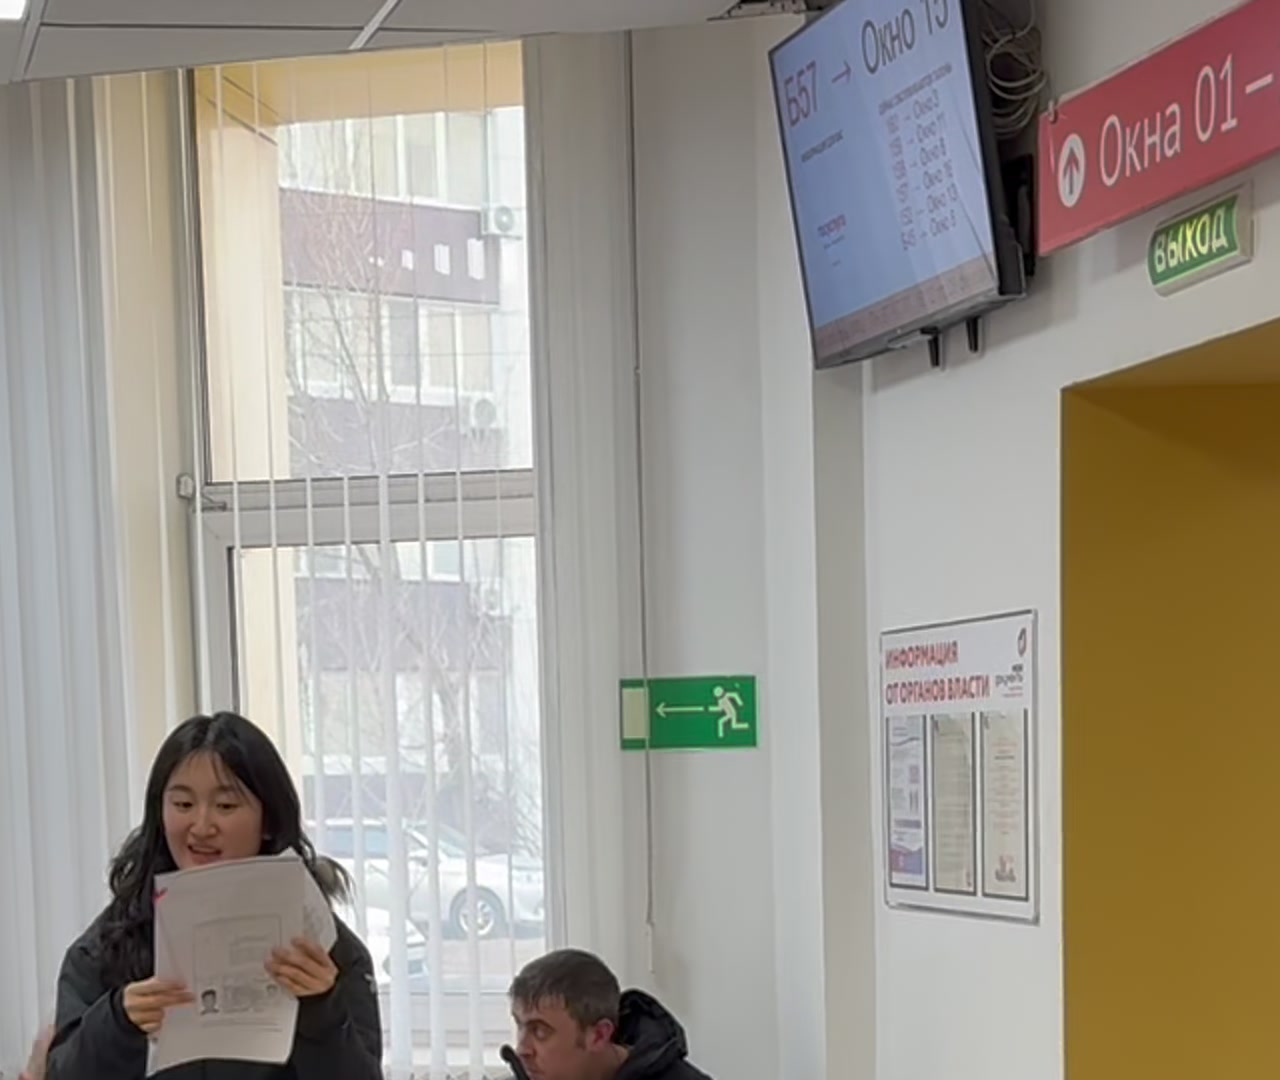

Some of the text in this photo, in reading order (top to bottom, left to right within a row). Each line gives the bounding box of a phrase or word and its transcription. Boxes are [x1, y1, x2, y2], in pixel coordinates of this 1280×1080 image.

[861, 8, 915, 75] Окно
[1099, 102, 1181, 187] Окна
[1153, 206, 1229, 274] ВЫХОД
[885, 640, 959, 670] ИНФОРМАЦИЯ
[885, 682, 900, 705] ОТ
[900, 676, 946, 704] ОРГАНОВ
[948, 674, 991, 701] ВЛАСТИ
